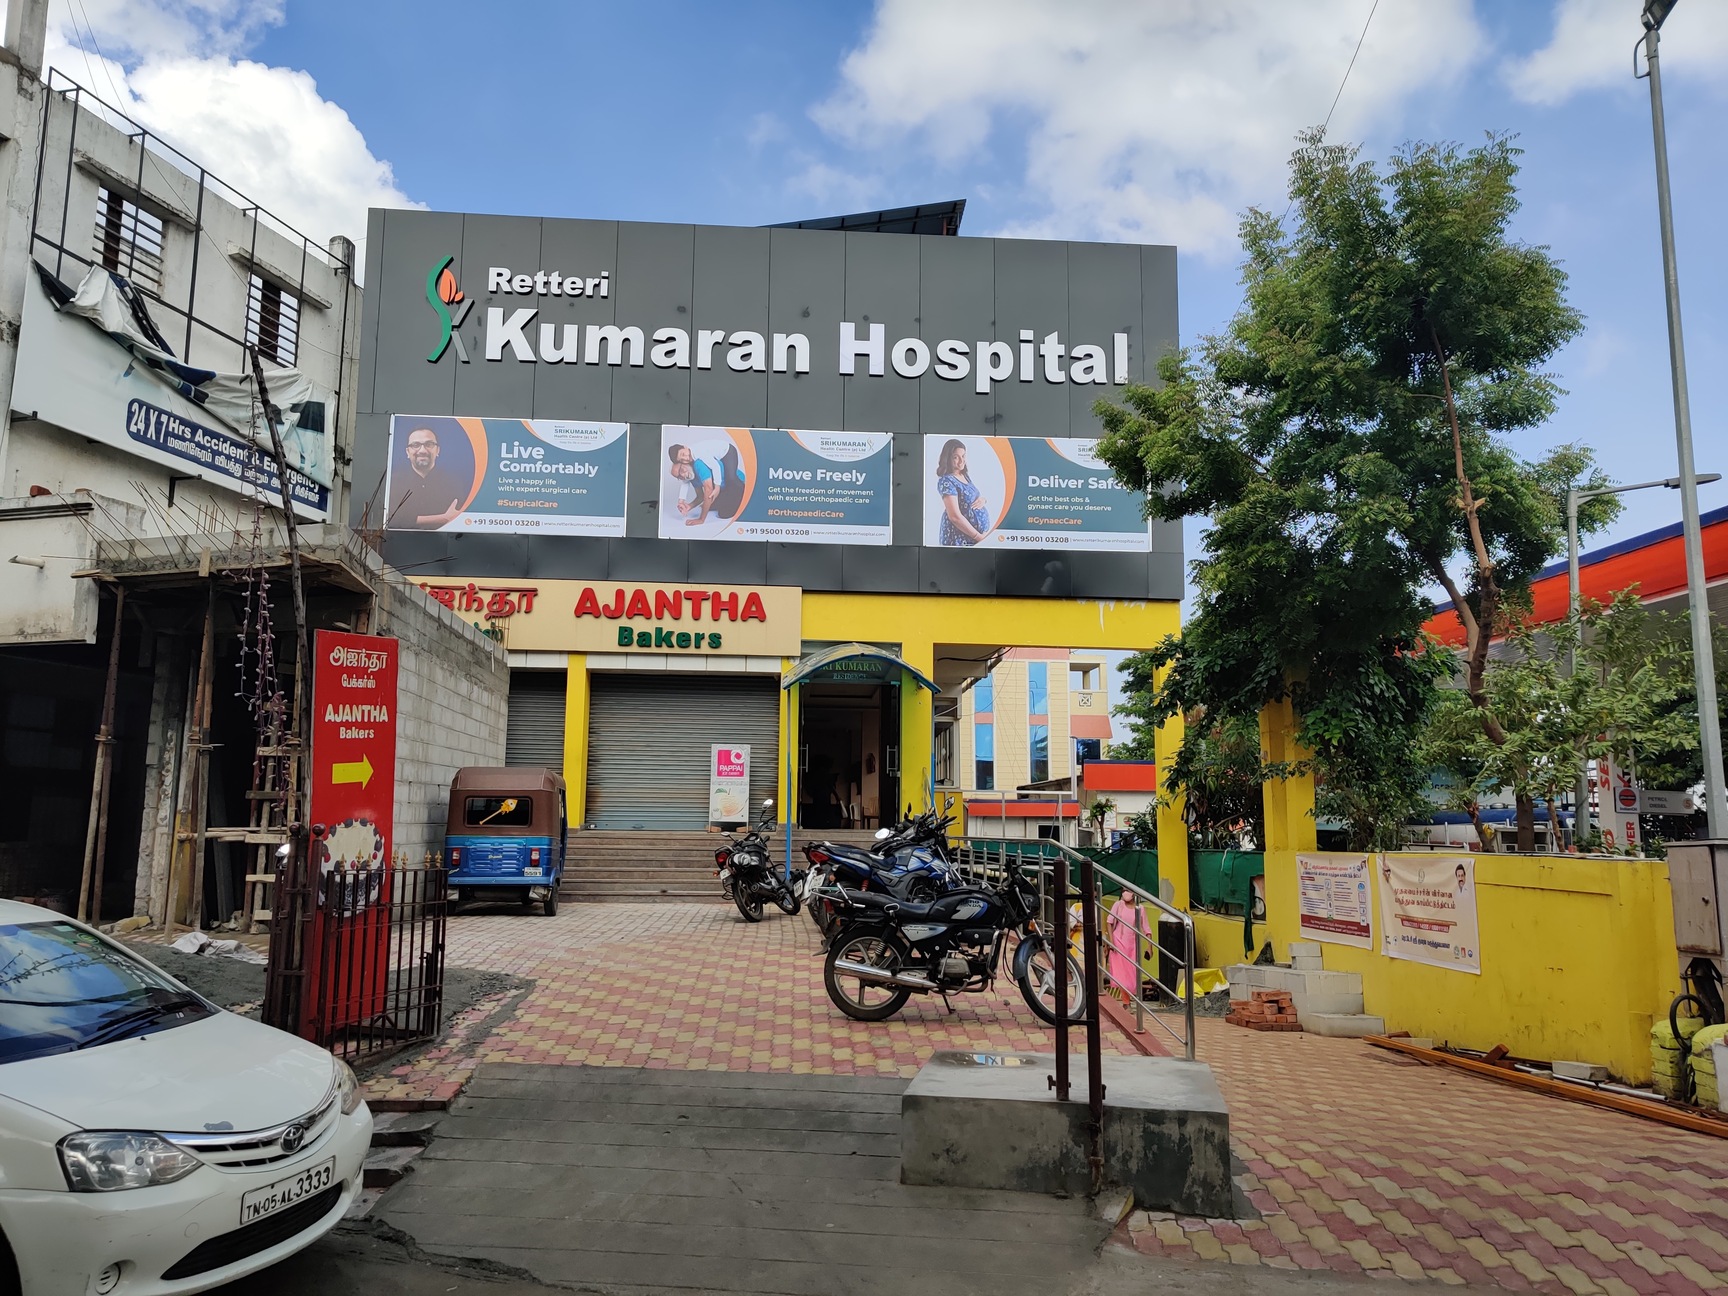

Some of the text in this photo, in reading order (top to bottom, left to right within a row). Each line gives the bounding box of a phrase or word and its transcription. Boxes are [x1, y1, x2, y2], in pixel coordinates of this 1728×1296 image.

[487, 266, 610, 298] Retteri
[484, 306, 1130, 395] Kumaran Hospital
[129, 402, 147, 436] 24
[146, 408, 159, 441] X
[160, 413, 169, 444] 7
[168, 417, 192, 439] Hrs
[194, 428, 249, 463] Accident
[263, 456, 320, 493] Emrgency
[167, 436, 213, 462] மணிநேரம்
[500, 441, 545, 460] Live
[820, 440, 867, 448] SRIKUMARAN
[499, 459, 599, 478] Comfortably
[521, 478, 545, 487] happy
[546, 478, 557, 486] life
[768, 467, 867, 486] Move Freely
[1028, 475, 1084, 490] Deliver
[516, 486, 540, 495] expert
[541, 486, 570, 495] surgical
[768, 486, 780, 494] Get
[782, 486, 794, 494] the
[796, 487, 826, 495] freedom
[836, 488, 874, 496] movement
[497, 498, 558, 510] #SurgicalCare
[768, 494, 784, 502] with
[786, 496, 808, 504] expert
[810, 496, 853, 504] Orthopaedic
[1028, 494, 1040, 502] Get
[1041, 494, 1054, 502] the
[768, 508, 845, 518] #OrthopaedicCare
[1028, 504, 1053, 512] gynaec
[1070, 504, 1084, 512] you
[1084, 504, 1112, 512] deserve
[473, 518, 487, 526] +91
[514, 519, 541, 527] 03208
[1027, 516, 1082, 526] #GynaecCare
[760, 528, 783, 536] 95001
[785, 528, 810, 536] 03208
[420, 582, 539, 622] ஜந்தா
[573, 586, 767, 623] AJANTHA
[617, 625, 723, 650] Bakers
[329, 645, 389, 674] அஜந்தா
[836, 661, 882, 672] KUMARAN
[341, 673, 377, 690] பேக்கர்ஸ்
[324, 704, 389, 723] AJANTHA
[339, 726, 375, 740] Bakers
